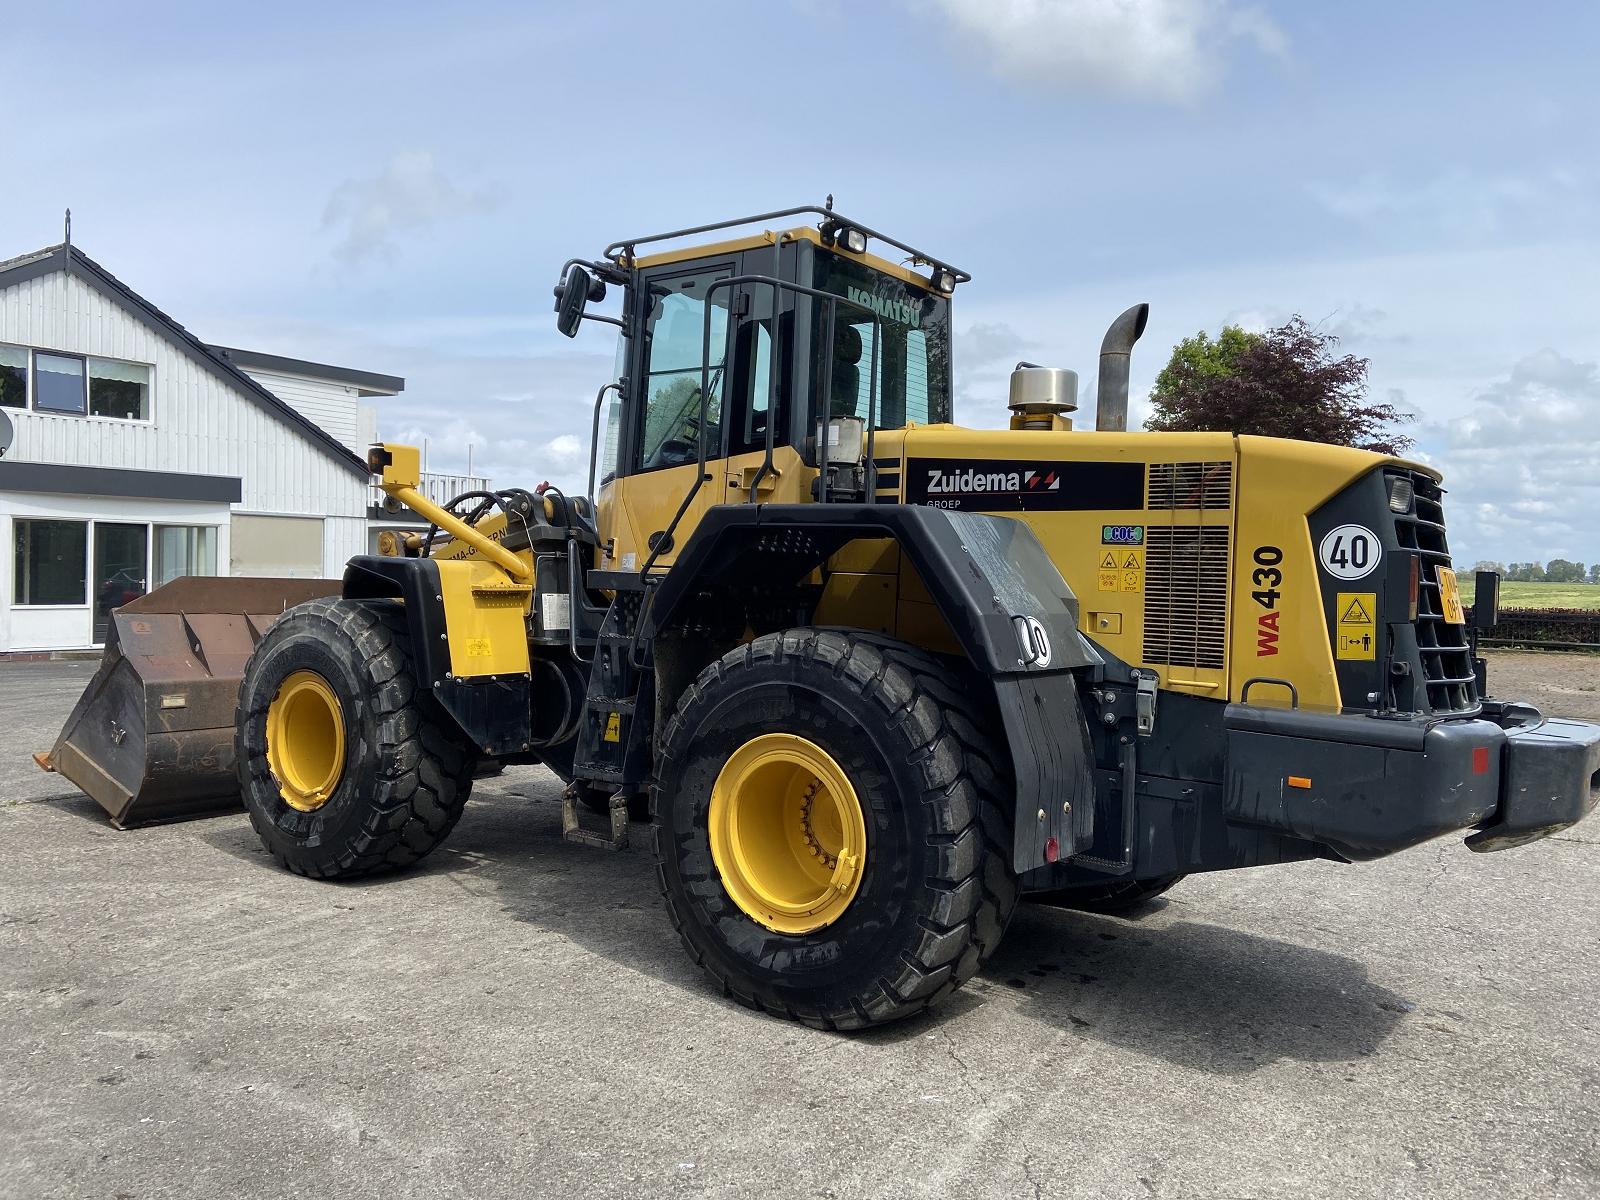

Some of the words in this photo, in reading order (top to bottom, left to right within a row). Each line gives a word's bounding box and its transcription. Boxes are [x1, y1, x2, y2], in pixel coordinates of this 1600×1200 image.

[847, 285, 923, 328] KOMATSU
[927, 468, 1020, 493] Zuidema
[927, 500, 961, 509] GROEP
[1329, 534, 1369, 569] 40
